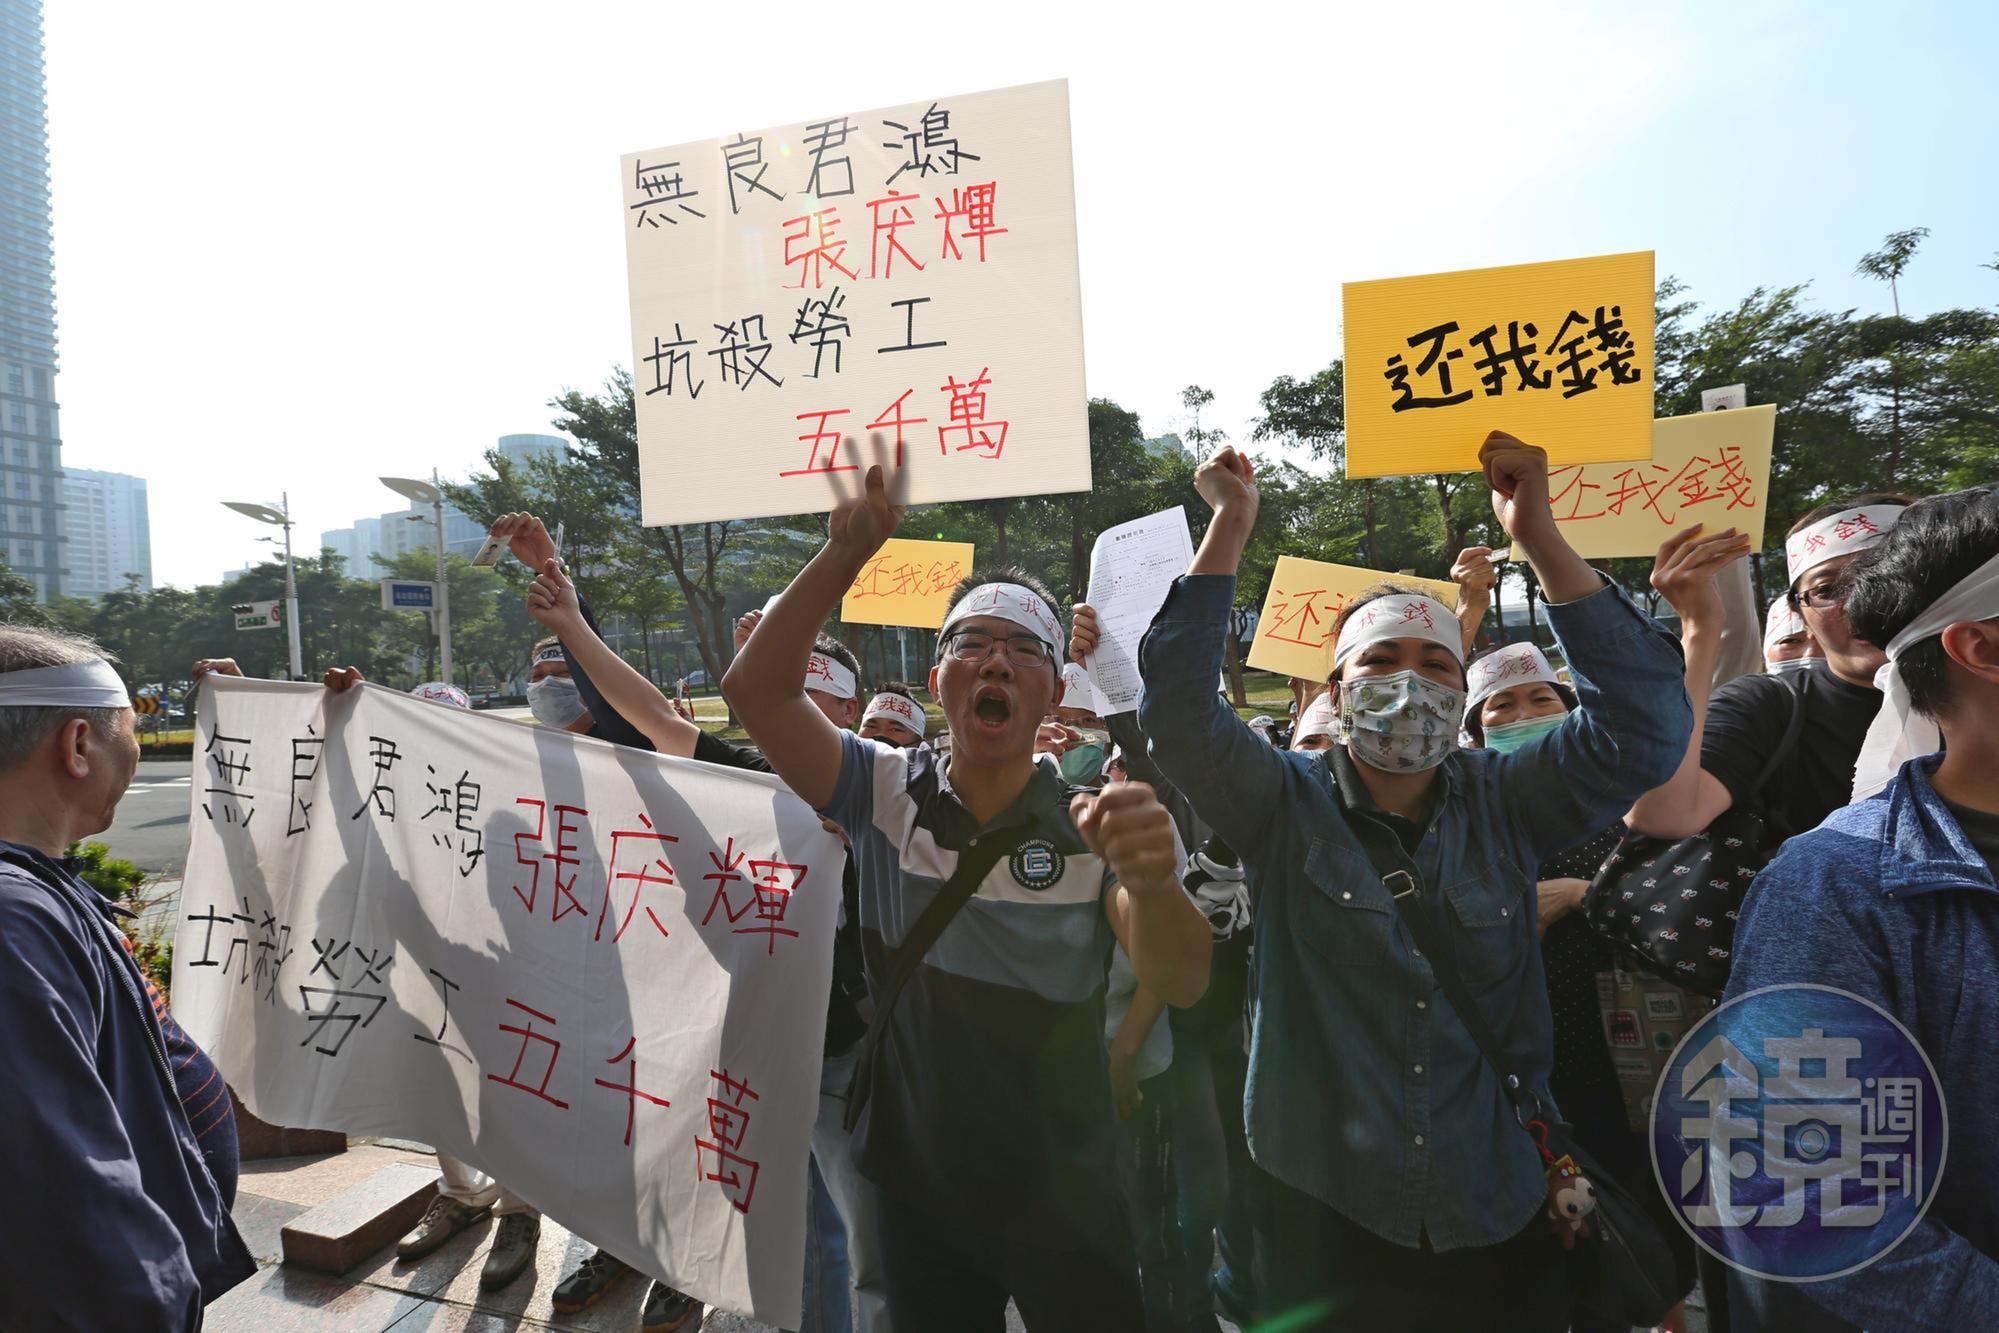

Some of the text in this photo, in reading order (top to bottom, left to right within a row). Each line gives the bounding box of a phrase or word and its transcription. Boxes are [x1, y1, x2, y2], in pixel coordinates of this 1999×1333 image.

[630, 102, 981, 228] 無良君鴻
[643, 286, 947, 399] 坑殺勞工
[1384, 306, 1641, 413] 还我錢
[780, 367, 1009, 478] 五千萬
[488, 998, 761, 1214] 五千萬
